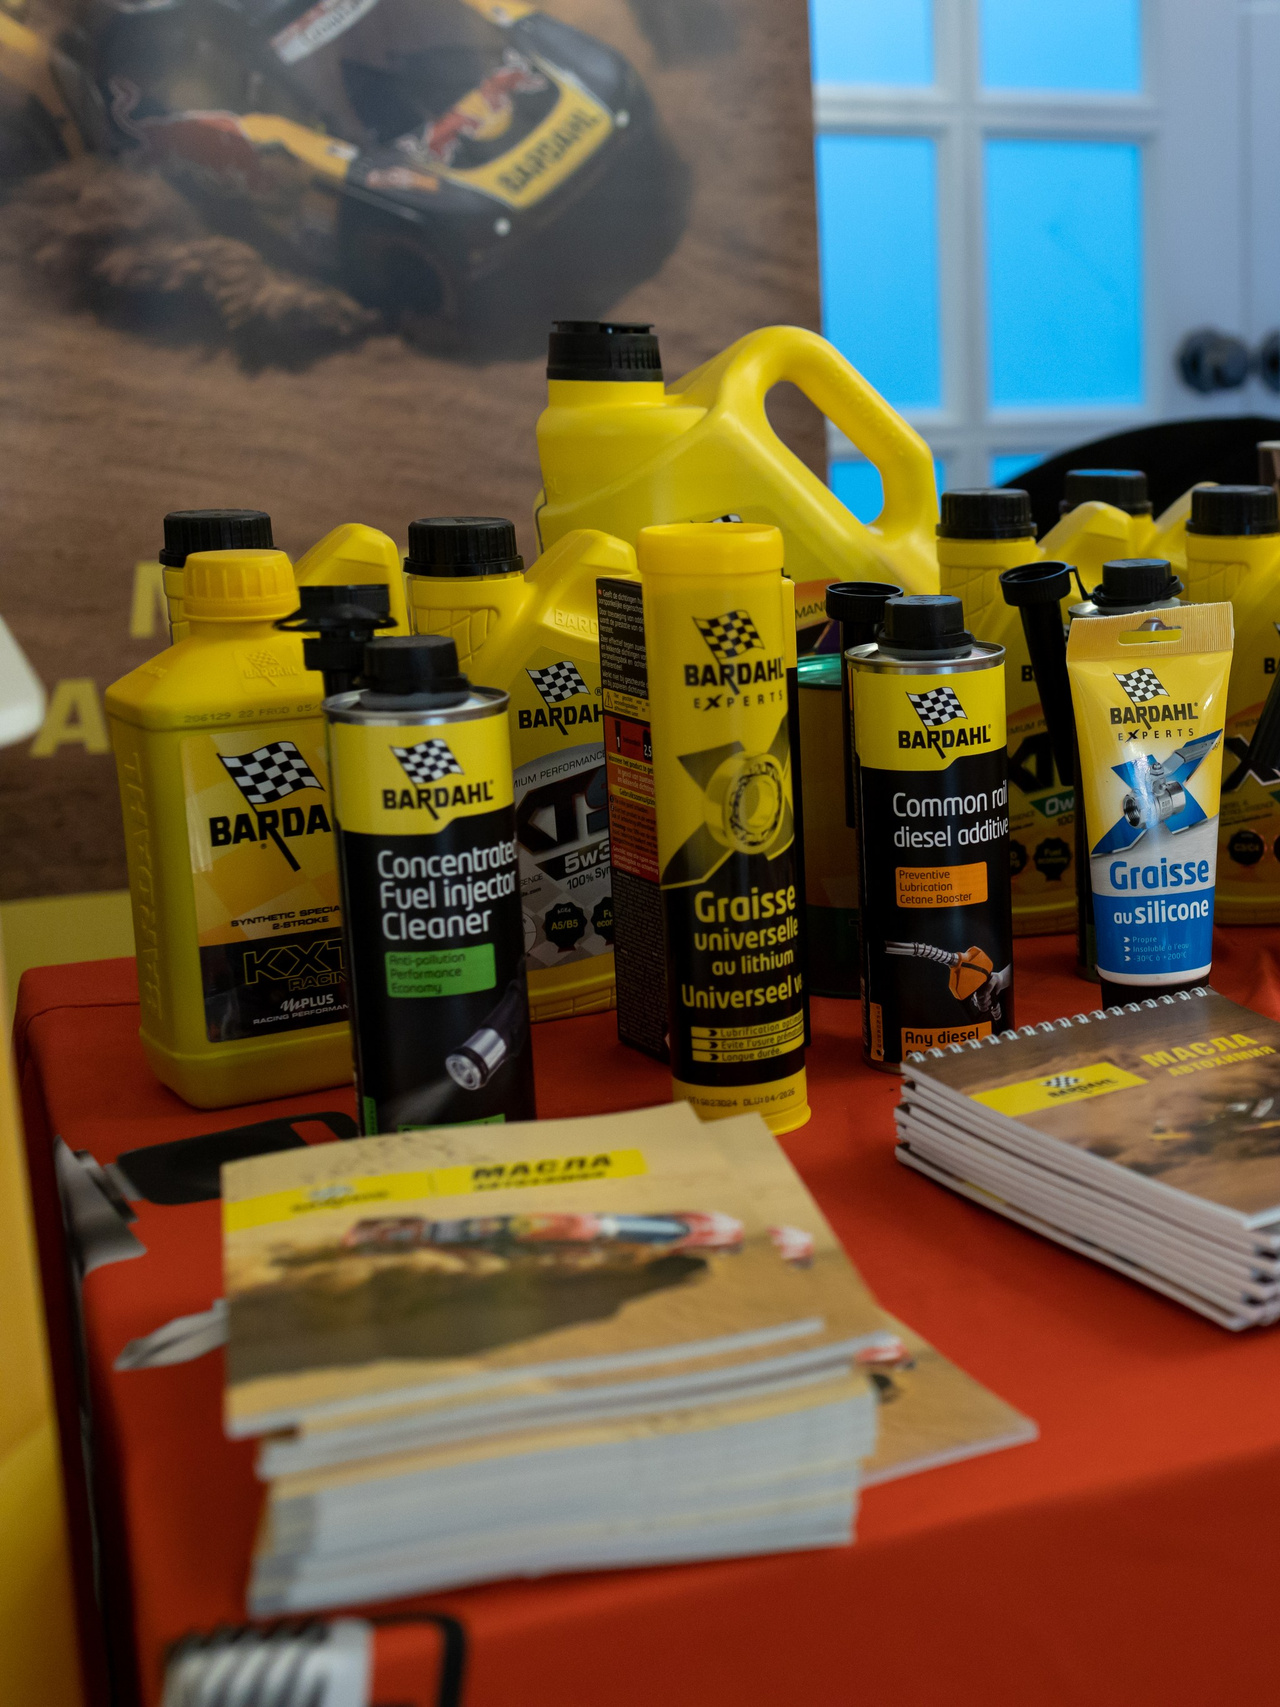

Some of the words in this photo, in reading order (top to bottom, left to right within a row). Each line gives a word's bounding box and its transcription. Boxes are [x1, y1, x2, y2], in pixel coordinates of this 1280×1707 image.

[684, 656, 785, 696] BARDAHL
[694, 690, 784, 712] EXPERTS
[1110, 702, 1199, 731] BARDAHL
[898, 724, 992, 760] BARDAHL
[1118, 728, 1195, 743] EXPERTS
[382, 781, 492, 821] BARDAHL
[892, 792, 988, 818] Common
[992, 779, 1009, 810] rail
[893, 825, 952, 849] diesel
[957, 816, 1009, 847] additive
[566, 872, 594, 891] 100%
[899, 869, 951, 881] Preventive
[899, 881, 954, 892] Lubrication
[1109, 858, 1210, 891] Graisse
[379, 879, 438, 911] Fuel
[442, 868, 517, 914] injector
[900, 894, 934, 905] Cetane
[936, 892, 973, 904] Booster
[694, 884, 797, 924] Graisse
[1113, 911, 1133, 925] au
[1134, 899, 1210, 925] silicone
[231, 911, 296, 927] SYNTHETIC
[272, 916, 330, 930] 2-STROKE
[381, 908, 492, 942] Cleaner
[551, 918, 580, 932] A5/B5
[694, 916, 799, 952] universelle
[1132, 936, 1158, 945] Propre
[389, 951, 467, 967] Anti-pollution
[712, 959, 737, 977] au
[741, 949, 794, 976] lithium
[390, 966, 463, 981] Performance
[391, 981, 443, 995] Economy
[681, 977, 793, 1010] Universeel
[252, 1013, 290, 1026] RACING
[720, 1022, 780, 1038] Lubrification
[904, 1030, 934, 1048] Any
[937, 1026, 980, 1045] diesel
[721, 1052, 755, 1063] Longue
[1139, 1033, 1259, 1068] МАСЛА
[1167, 1045, 1277, 1077] АВТОХИМИЯ
[473, 1153, 612, 1181] МАСЛА
